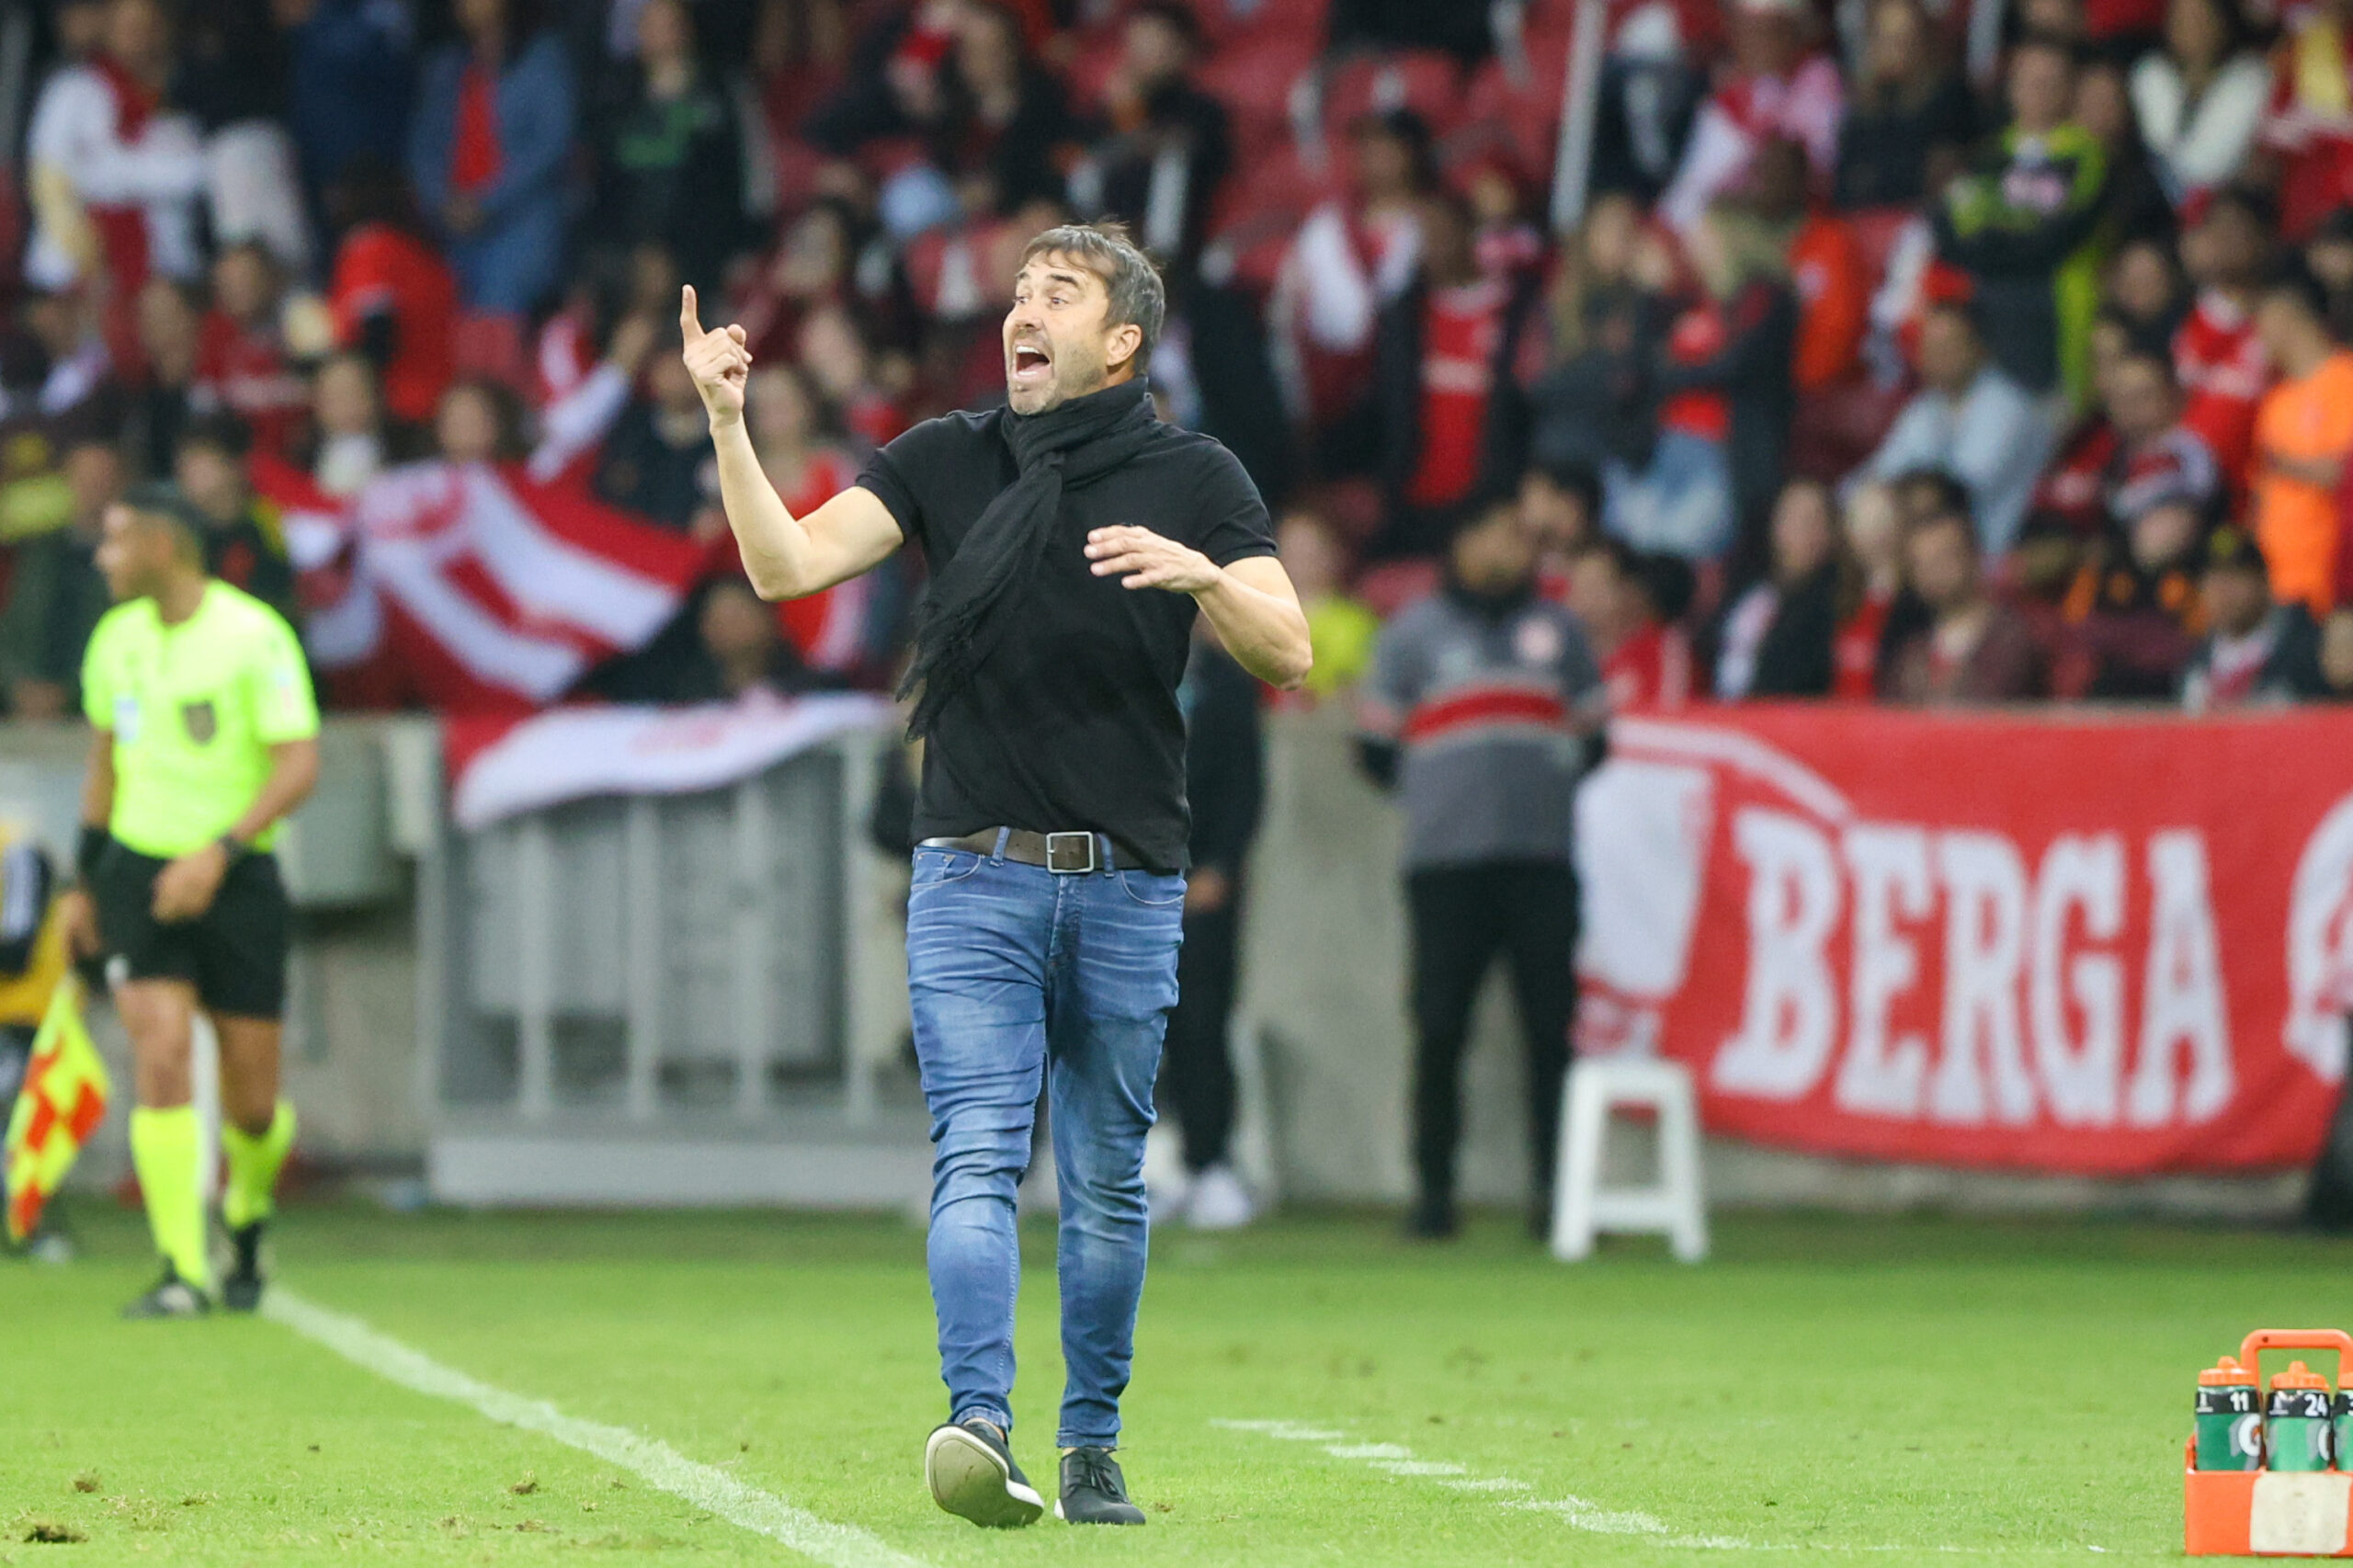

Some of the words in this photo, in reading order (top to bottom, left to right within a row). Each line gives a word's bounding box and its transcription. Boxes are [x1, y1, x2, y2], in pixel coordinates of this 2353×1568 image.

[1711, 805, 2234, 1128] BERGA
[2230, 1391, 2250, 1412] 11
[2303, 1393, 2329, 1416] 24
